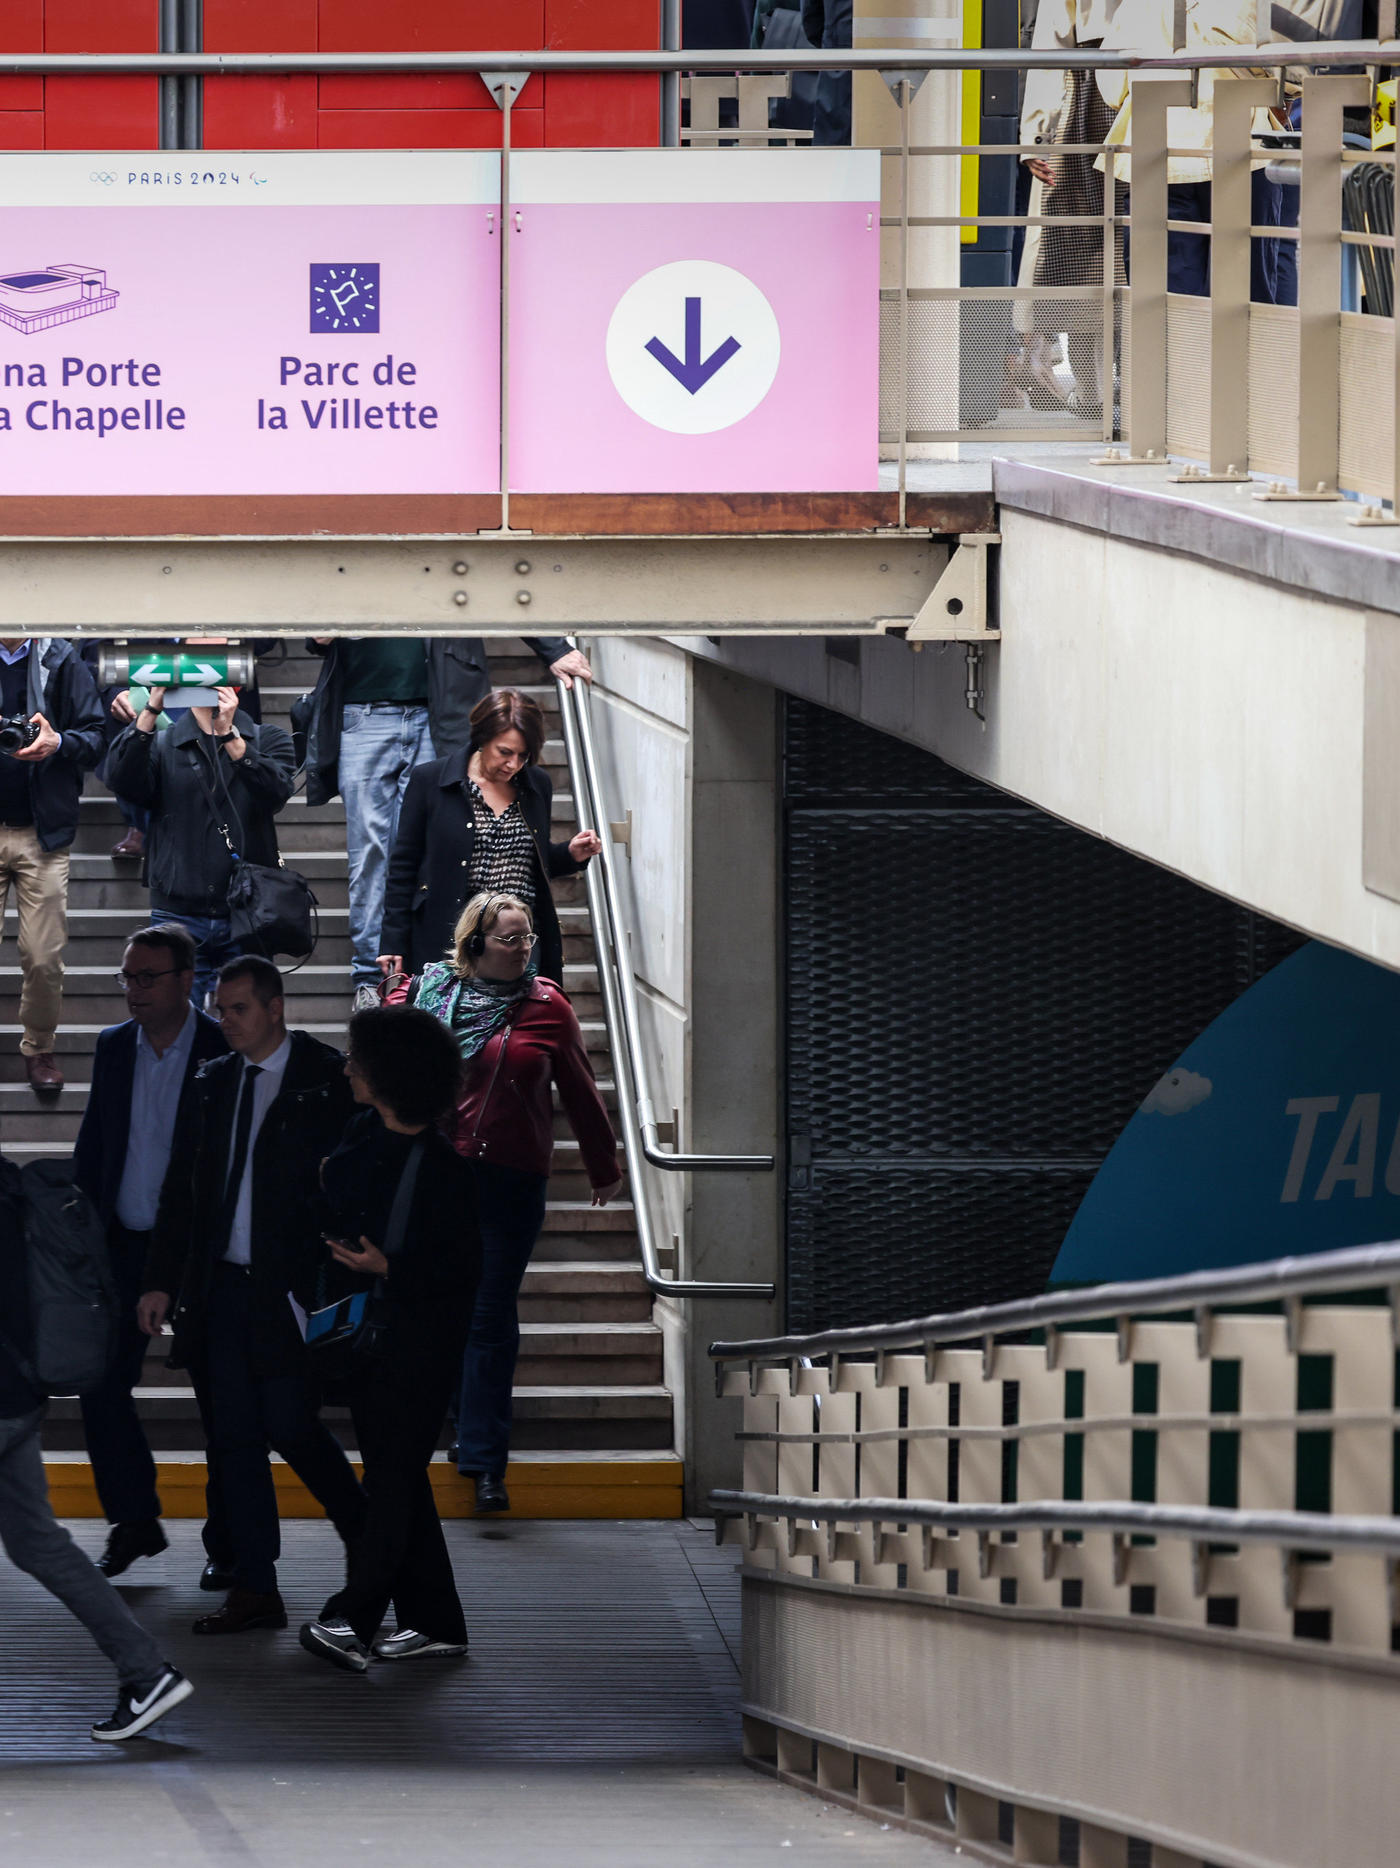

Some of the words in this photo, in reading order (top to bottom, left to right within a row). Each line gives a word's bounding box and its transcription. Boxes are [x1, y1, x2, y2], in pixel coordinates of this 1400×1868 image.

[190, 172, 240, 185] 2024
[62, 357, 161, 388] Porte
[280, 356, 359, 386] Parc
[372, 355, 417, 386] de
[25, 399, 186, 438] Chapelle
[258, 398, 289, 430] la
[300, 398, 438, 430] Villette
